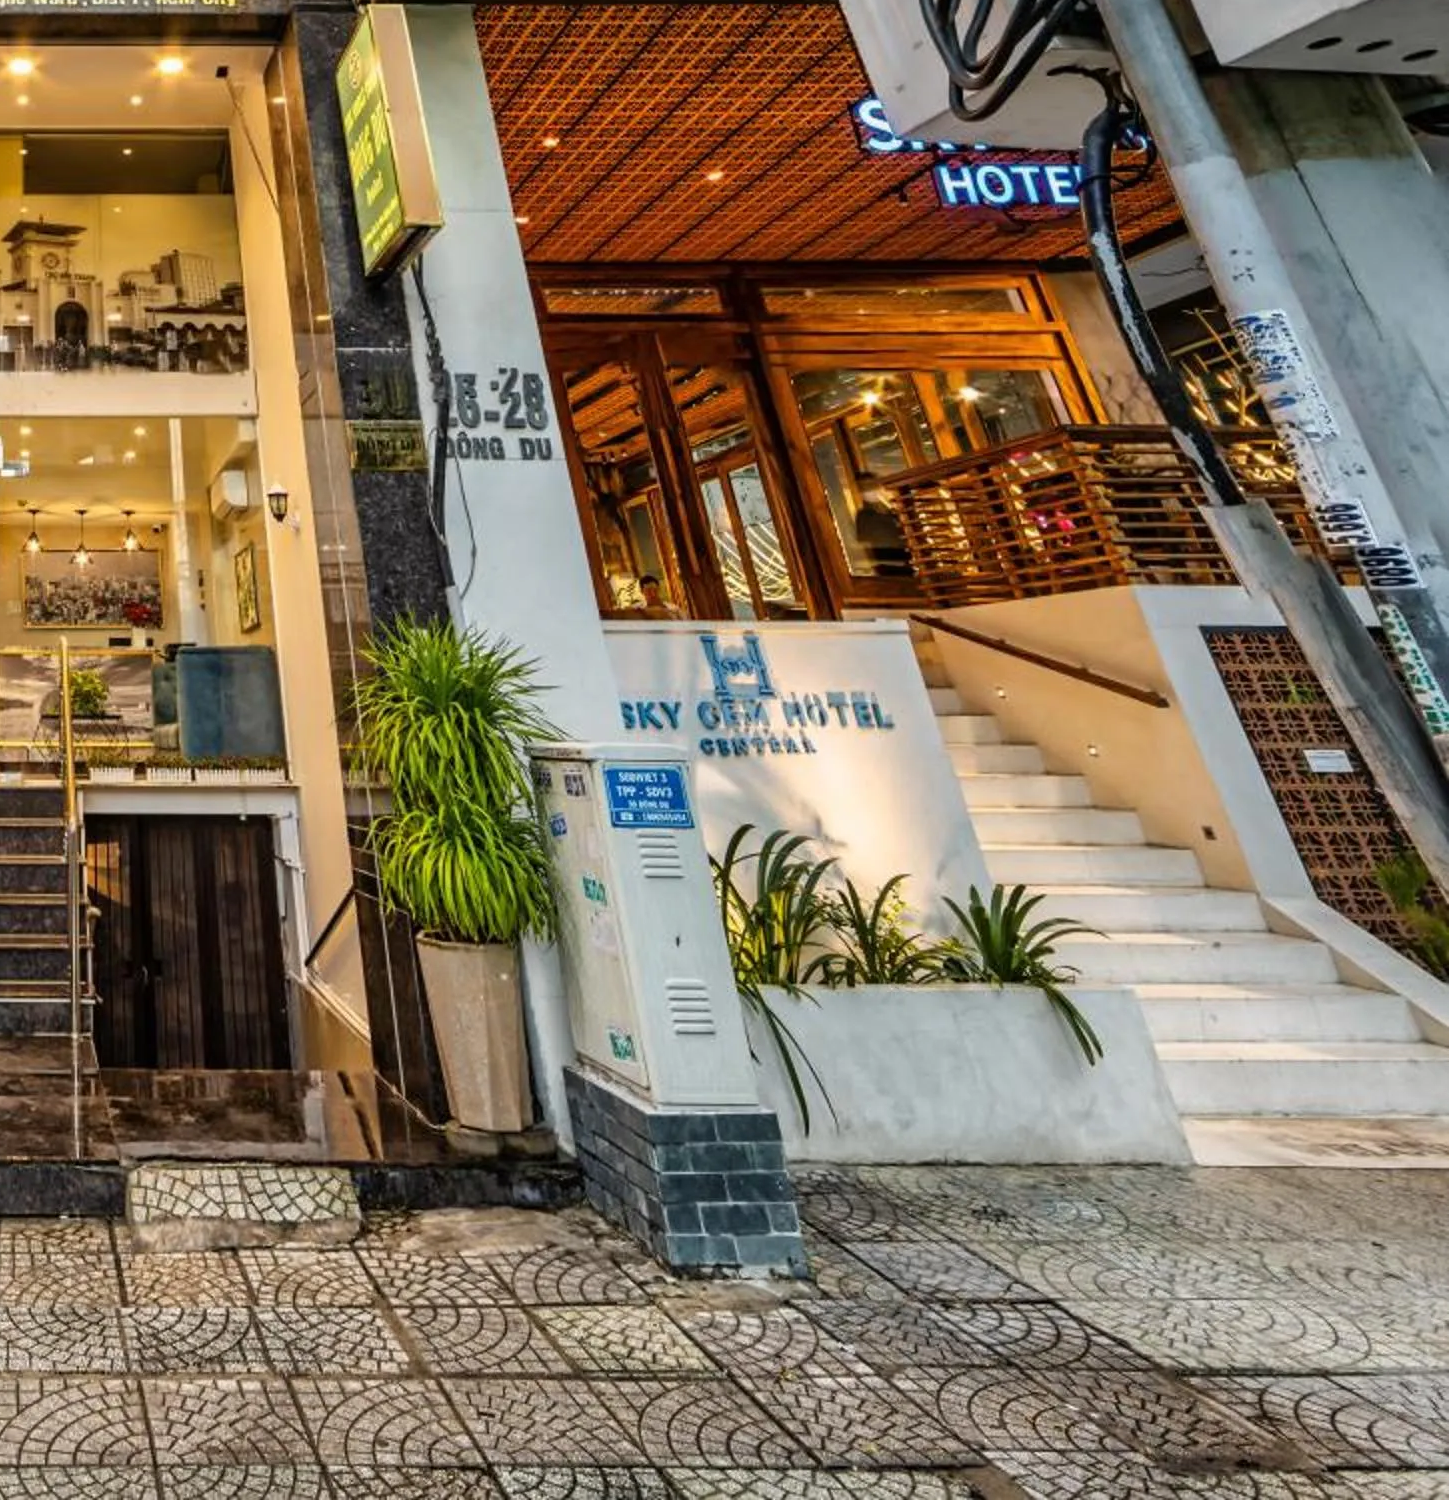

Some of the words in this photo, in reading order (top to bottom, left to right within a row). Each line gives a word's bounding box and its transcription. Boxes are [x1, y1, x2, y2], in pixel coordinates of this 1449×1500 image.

[937, 163, 1084, 205] HOTE
[519, 437, 552, 460] DU
[620, 700, 682, 730] SKY
[782, 692, 896, 730] HOTEL
[698, 736, 818, 757] CENTRAL
